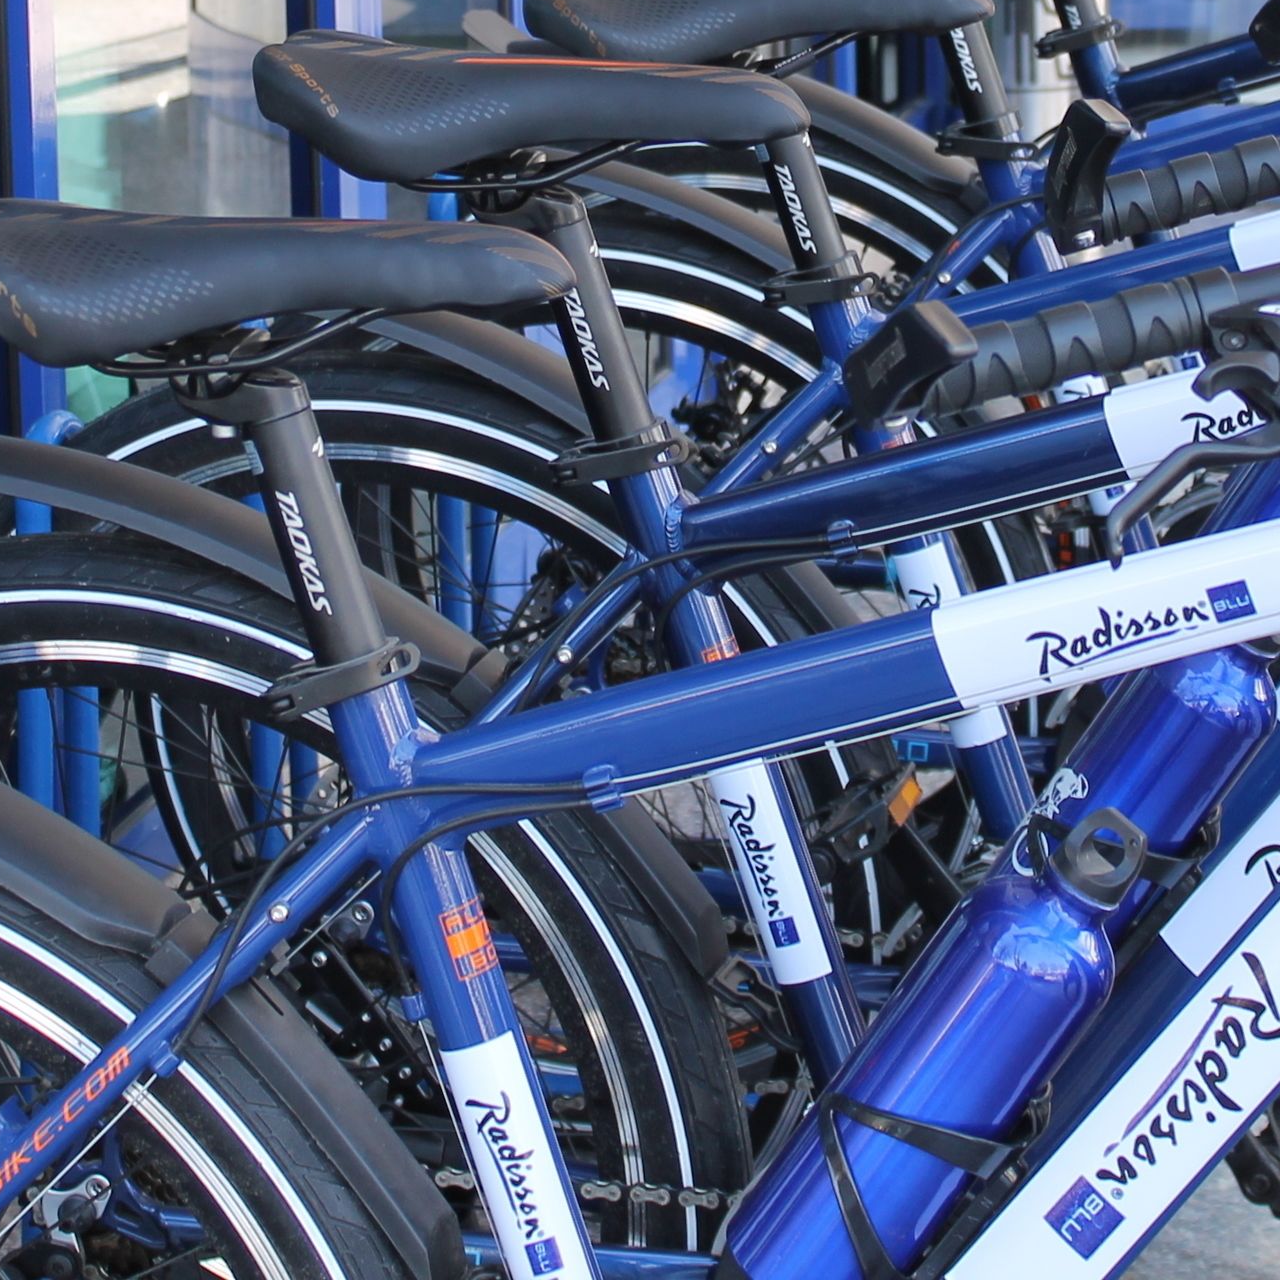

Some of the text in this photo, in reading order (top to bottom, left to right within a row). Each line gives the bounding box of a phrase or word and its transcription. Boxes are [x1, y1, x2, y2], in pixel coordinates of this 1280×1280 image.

[289, 63, 339, 118] Sports
[950, 27, 982, 94] AOKAS
[774, 164, 817, 254] TAOKAS
[564, 287, 610, 391] TAOKAS
[275, 490, 332, 616] TAOKAS
[1026, 594, 1250, 683] Radisson BLU
[720, 794, 791, 945] Radisson BLU
[465, 1090, 552, 1273] Radisson BLU
[1060, 1193, 1105, 1242] BLU
